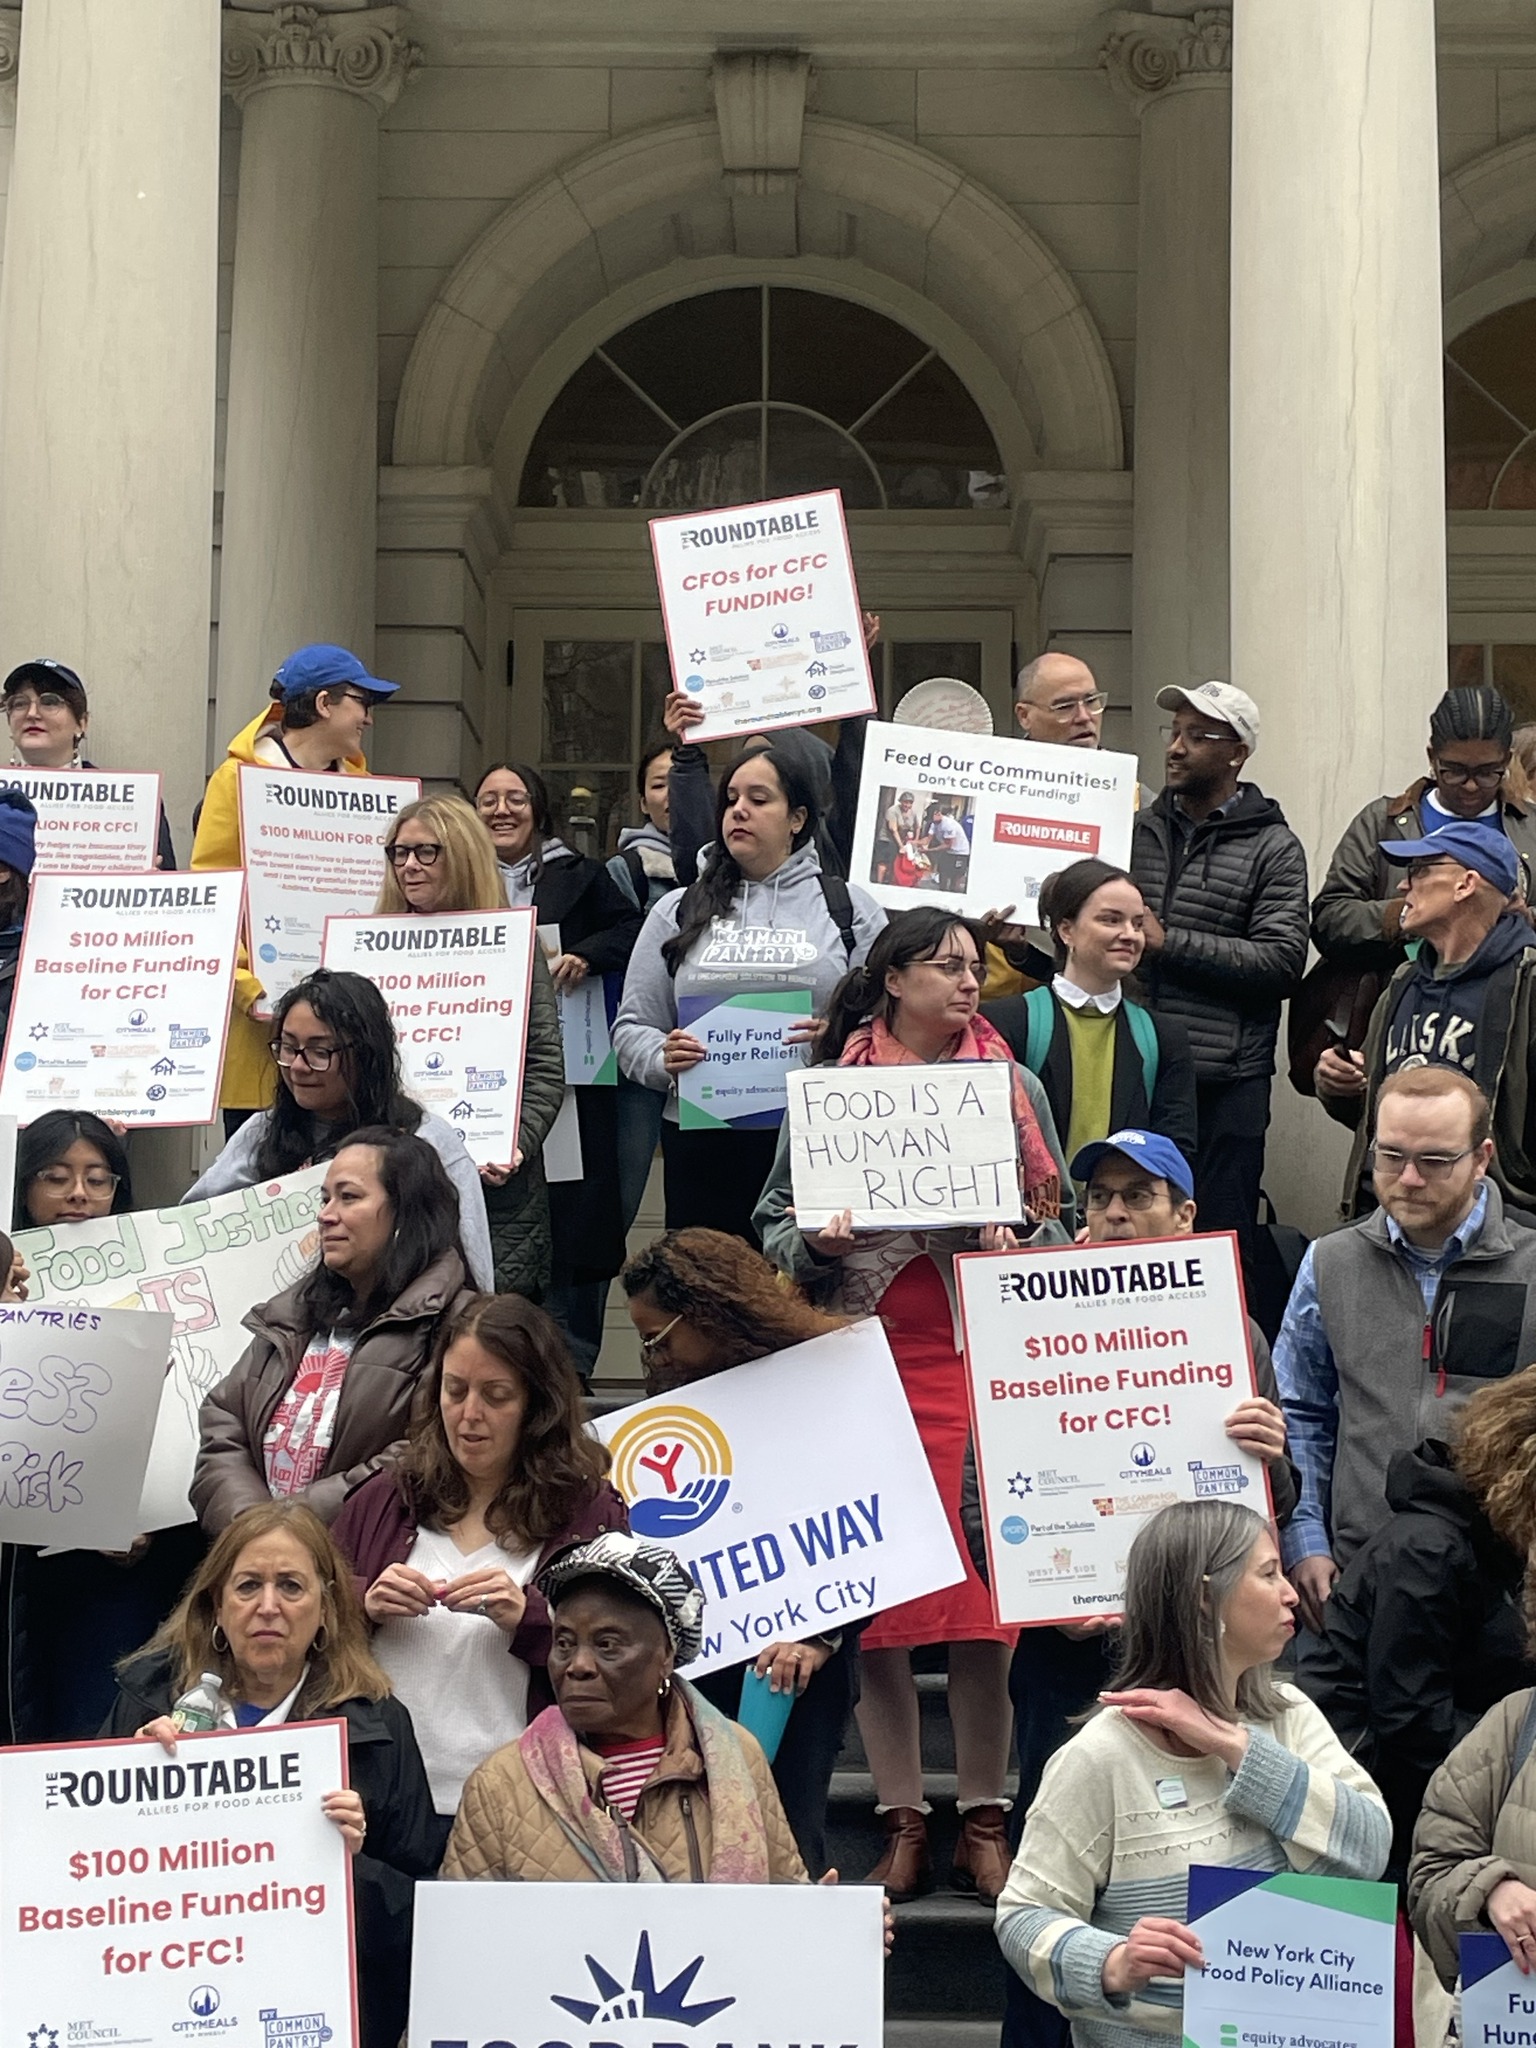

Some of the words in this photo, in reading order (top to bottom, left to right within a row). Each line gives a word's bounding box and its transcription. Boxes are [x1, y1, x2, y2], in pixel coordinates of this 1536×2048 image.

[690, 510, 819, 548] ROUNDTABLE
[682, 570, 740, 591] CFOs
[746, 564, 778, 582] for
[783, 553, 829, 574] CFC
[705, 583, 814, 617] FUNDING!
[884, 747, 932, 767] Feed
[937, 755, 975, 773] Our
[980, 760, 1118, 791] Communities!
[273, 784, 399, 814] ROUNDTABLE
[917, 773, 957, 788] Don't
[960, 777, 985, 791] Cut
[987, 781, 1016, 795] CFC
[1019, 786, 1081, 804] Funding!
[37, 820, 69, 831] LION
[72, 821, 101, 833] FOR
[104, 822, 138, 833] CFC!
[260, 824, 290, 838] $100
[293, 828, 344, 843] MILLION
[347, 833, 373, 845] FOR
[1003, 821, 1091, 845] ROUNDTABLE
[71, 885, 218, 909] ROUNDTABLE
[69, 931, 118, 948] $100
[123, 930, 194, 947] Million
[364, 925, 507, 952] ROUNDTABLE
[716, 929, 798, 944] COMMON
[34, 957, 127, 974] Baseline
[132, 955, 221, 975] Funding
[706, 945, 790, 962] PANTRY
[80, 984, 111, 1000] for
[116, 984, 167, 1000] CFC!
[417, 971, 486, 990] Million
[427, 997, 514, 1017] Funding
[412, 1026, 462, 1043] CFC!
[707, 1029, 742, 1046] Fully
[746, 1027, 782, 1041] Fund
[704, 1050, 747, 1065] unger
[751, 1046, 798, 1060] Relief!
[715, 1086, 743, 1097] equity
[802, 1081, 896, 1125] FOOD
[911, 1083, 940, 1116] IS
[957, 1081, 985, 1116] A
[805, 1123, 951, 1169] HUMAN
[863, 1158, 1013, 1210] RIGHT
[11, 1214, 147, 1301] Food
[998, 1273, 1010, 1304] THE
[1010, 1258, 1205, 1303] ROUNDTABLE
[139, 1271, 218, 1332] IS
[1074, 1300, 1108, 1310] ALLIES
[1111, 1297, 1132, 1307] FOR
[1135, 1294, 1165, 1304] FOOD
[1167, 1290, 1207, 1301] ACCESS
[1024, 1333, 1088, 1361] $100
[1094, 1325, 1189, 1355] Million
[989, 1369, 1110, 1401] Baseline
[1116, 1361, 1233, 1393] Funding
[1058, 1411, 1097, 1434] for
[1104, 1403, 1173, 1431] CFC!
[1196, 1468, 1238, 1481] COMMON
[1198, 1481, 1236, 1494] PANTRY
[688, 1533, 786, 1605] ITED
[789, 1493, 885, 1567] WAY
[730, 1598, 809, 1644] York
[814, 1576, 878, 1615] City
[46, 1772, 60, 1810] THE
[60, 1752, 302, 1809] ROUNDTABLE
[137, 1803, 180, 1817] ALLIES
[184, 1801, 209, 1813] FOR
[213, 1797, 251, 1810] FOOD
[255, 1791, 303, 1806] ACCESS
[68, 1847, 149, 1882] $100
[158, 1837, 275, 1873] Million
[18, 1896, 173, 1933] Baseline
[181, 1881, 326, 1920] Funding
[102, 1946, 153, 1976] for
[160, 1936, 245, 1970] CFC!
[1227, 1939, 1270, 1960] New
[1274, 1944, 1315, 1964] York
[1320, 1949, 1355, 1972] City
[1200, 1963, 1246, 1983] Food
[1251, 1967, 1305, 1993] Policy
[1309, 1973, 1384, 1996] Alliance
[67, 2020, 95, 2032] MET
[67, 2027, 122, 2041] COUNCIL
[172, 2016, 239, 2033] CITYMEALS
[268, 2017, 321, 2034] COMMON
[269, 2034, 316, 2048] PANTRY
[1242, 2030, 1286, 2048] equity
